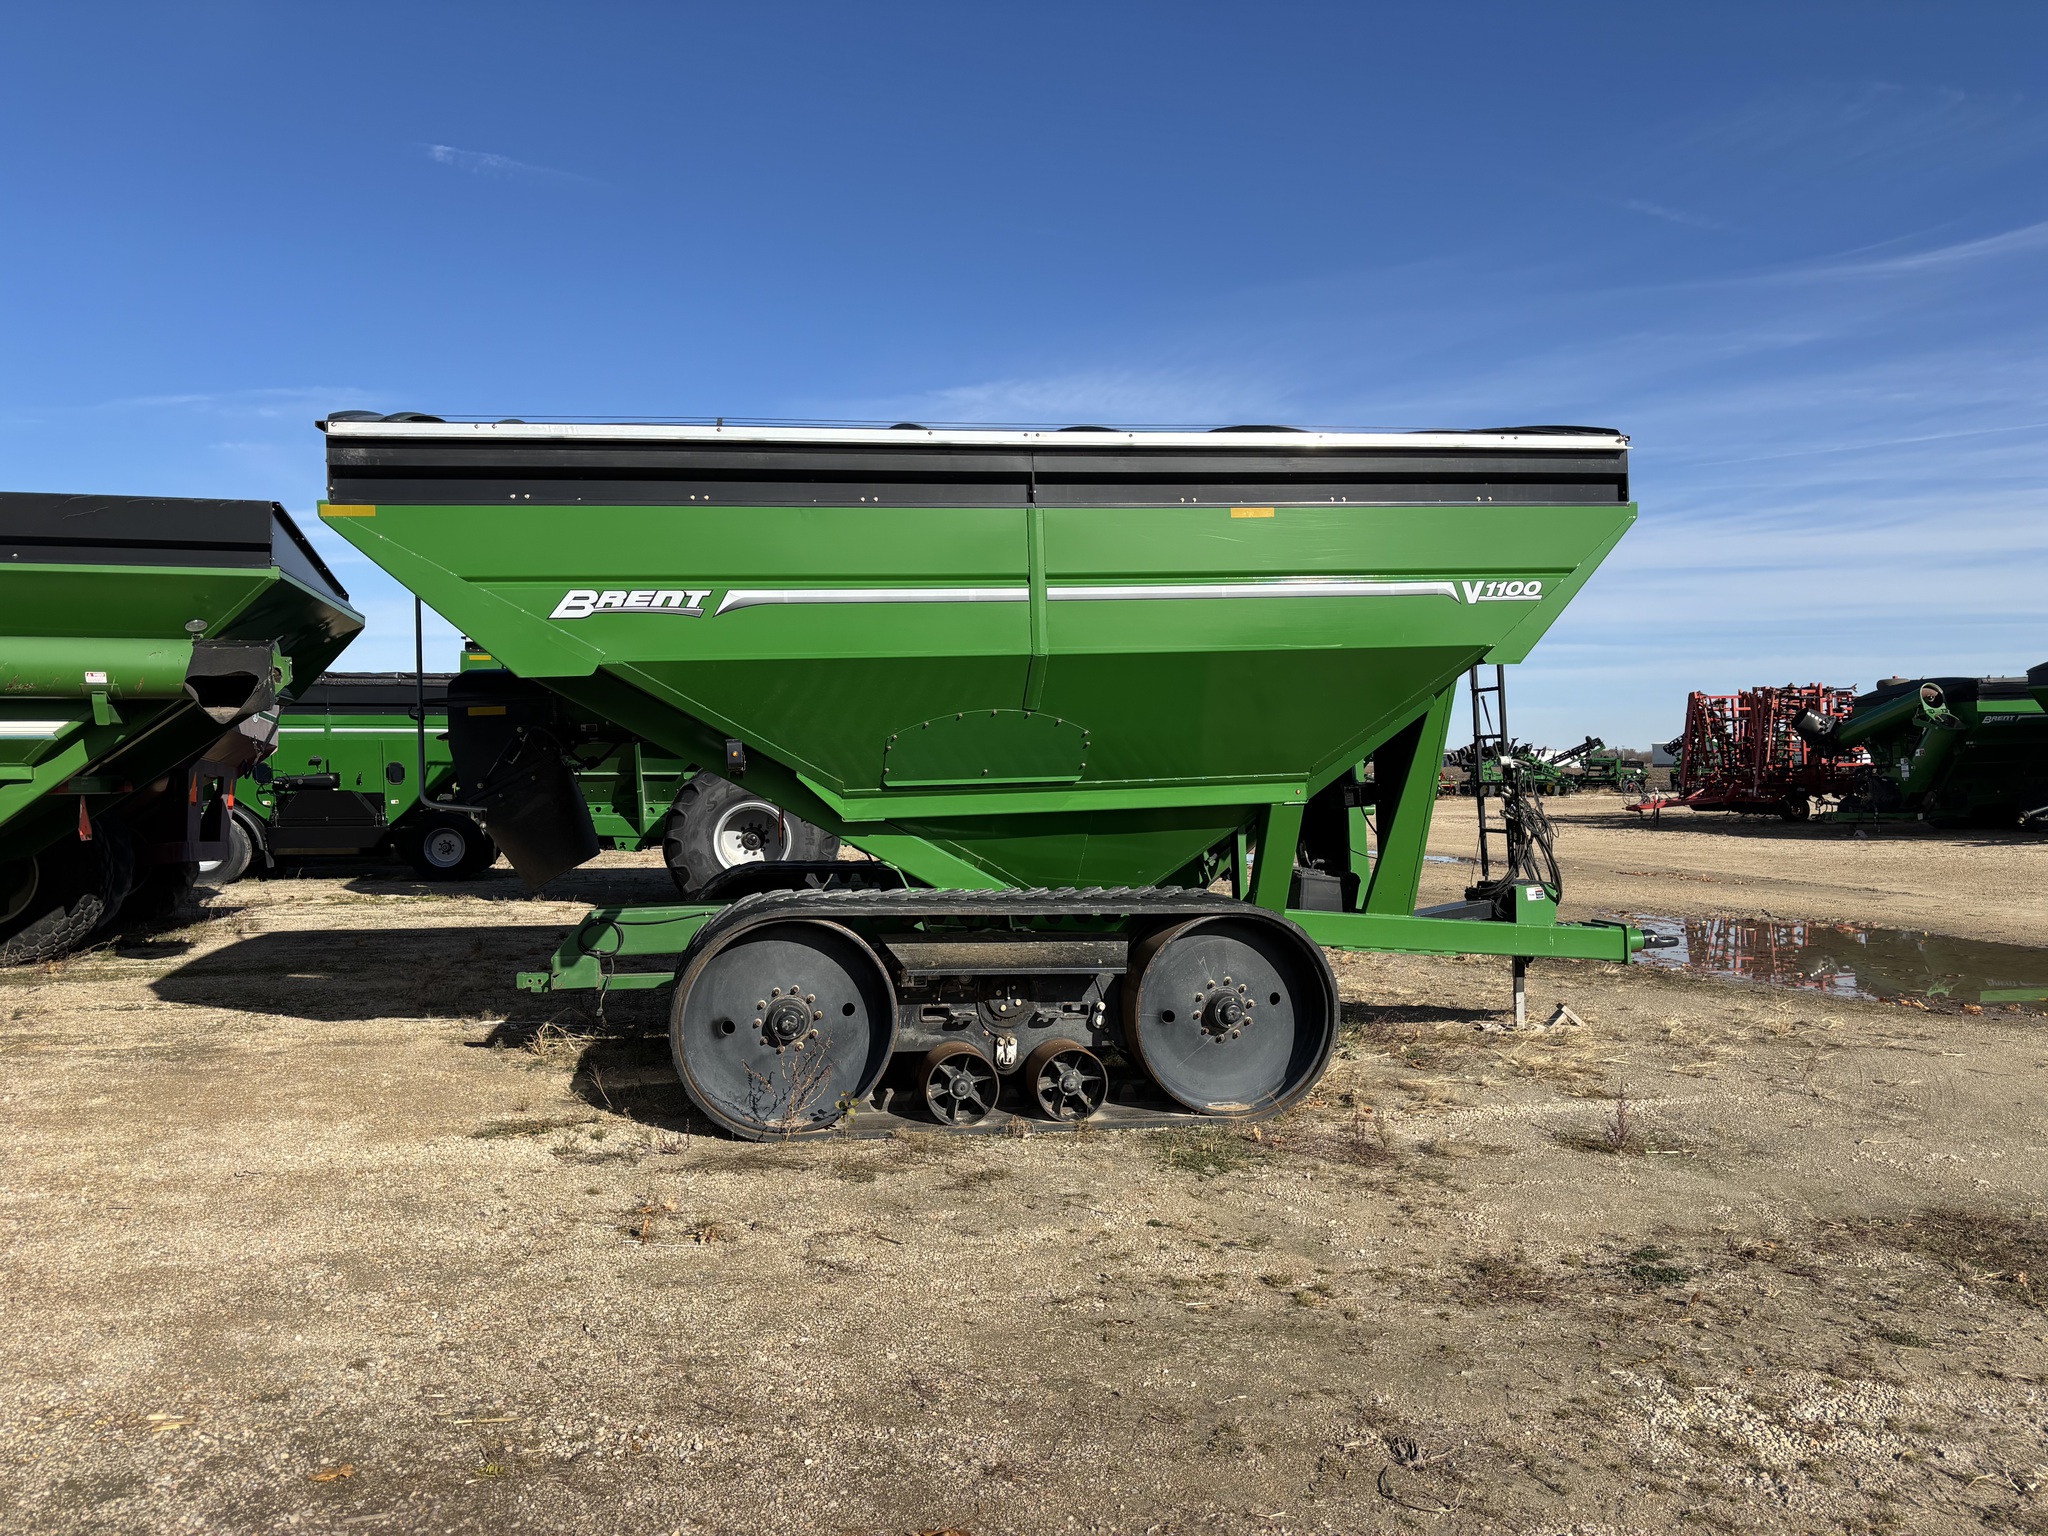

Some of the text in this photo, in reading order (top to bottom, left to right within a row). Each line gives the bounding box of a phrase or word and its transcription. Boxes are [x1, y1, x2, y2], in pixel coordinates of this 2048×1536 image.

[549, 589, 712, 619] BRENT
[1461, 580, 1542, 604] V1100
[1982, 715, 2015, 724] BRENT
